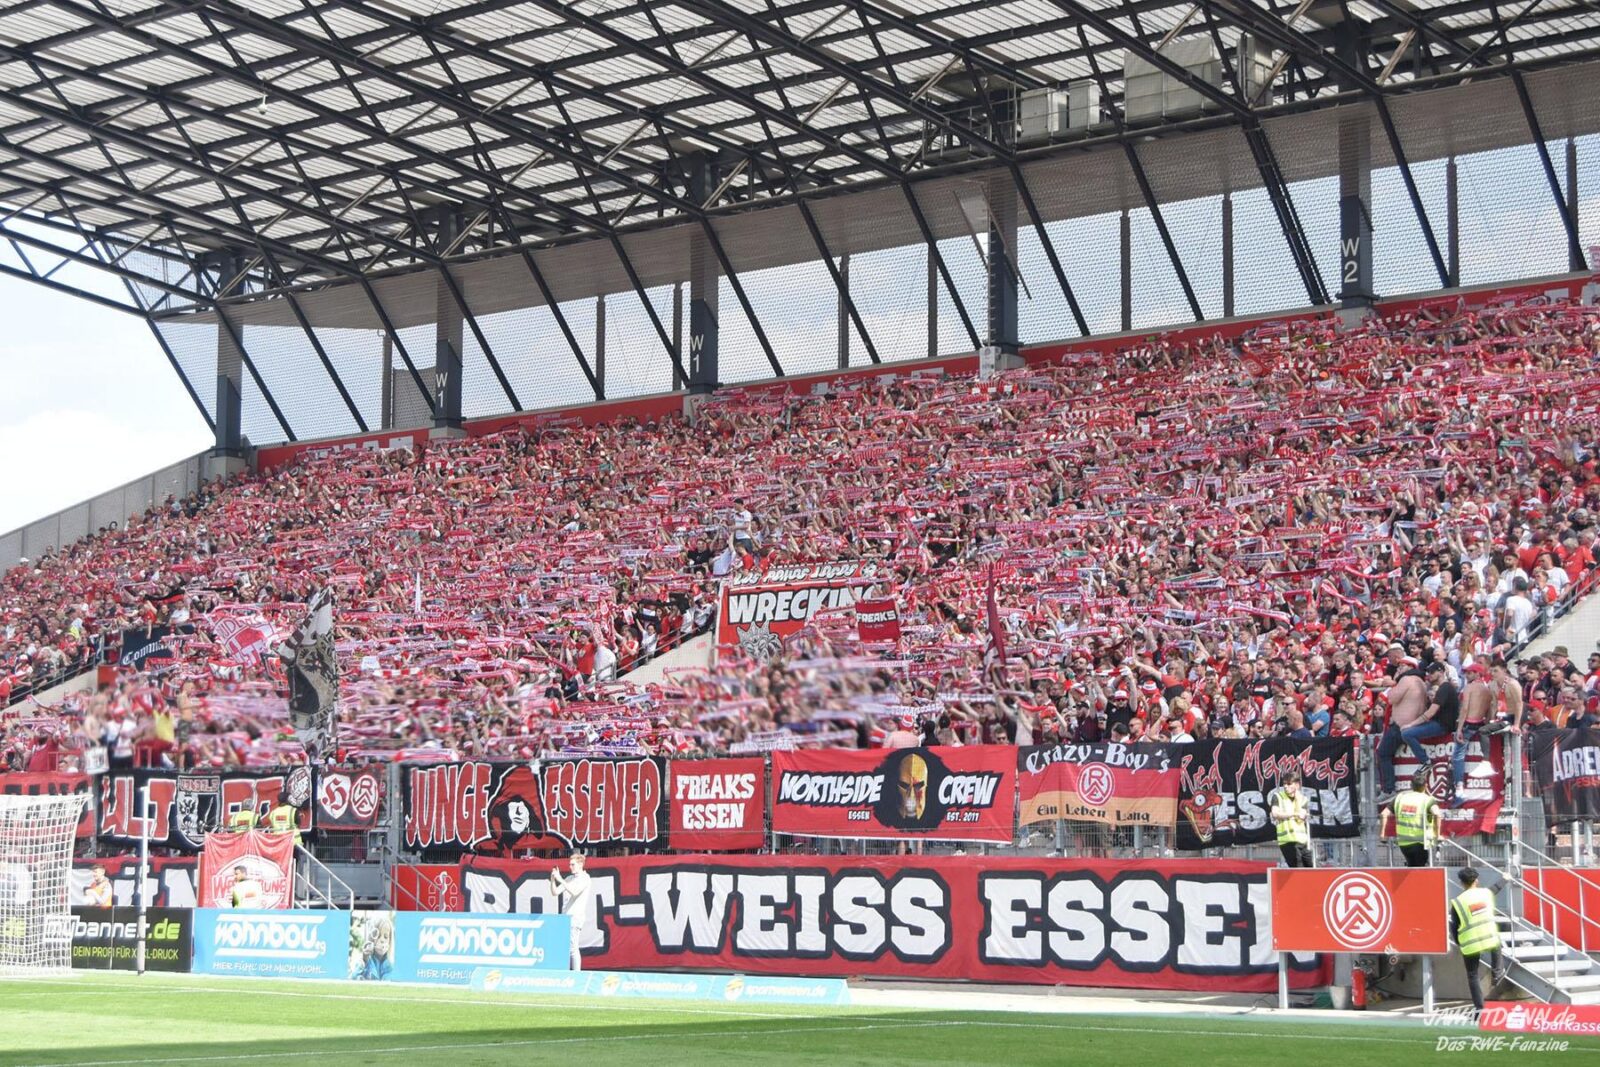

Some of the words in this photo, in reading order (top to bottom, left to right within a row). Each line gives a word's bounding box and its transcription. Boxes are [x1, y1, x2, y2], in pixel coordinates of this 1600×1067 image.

[1344, 260, 1358, 284] 2
[856, 609, 898, 623] FREAKS
[1180, 741, 1224, 797] Red
[1235, 738, 1350, 794] Mambas
[675, 772, 757, 801] FREAKS
[779, 772, 886, 806] NORTHSIDE
[938, 774, 999, 806] CREW
[1466, 778, 1491, 789] 2015
[404, 760, 492, 850] JUNGE
[543, 757, 662, 845] ESSENER
[1037, 803, 1059, 817] Ein
[1065, 803, 1107, 819] Leben
[1115, 809, 1152, 823] Lang
[1213, 785, 1354, 831] ESEN
[682, 802, 746, 830] ESSEN
[847, 809, 871, 822] ESSEN
[946, 811, 962, 822] EST.
[418, 921, 536, 956] wohnbau
[73, 945, 91, 957] DEIN
[92, 946, 115, 958] PROFI
[116, 945, 131, 959] FÜR
[213, 961, 234, 970] HIER
[416, 968, 439, 979] HIER
[1531, 1019, 1600, 1034] Sparkasse
